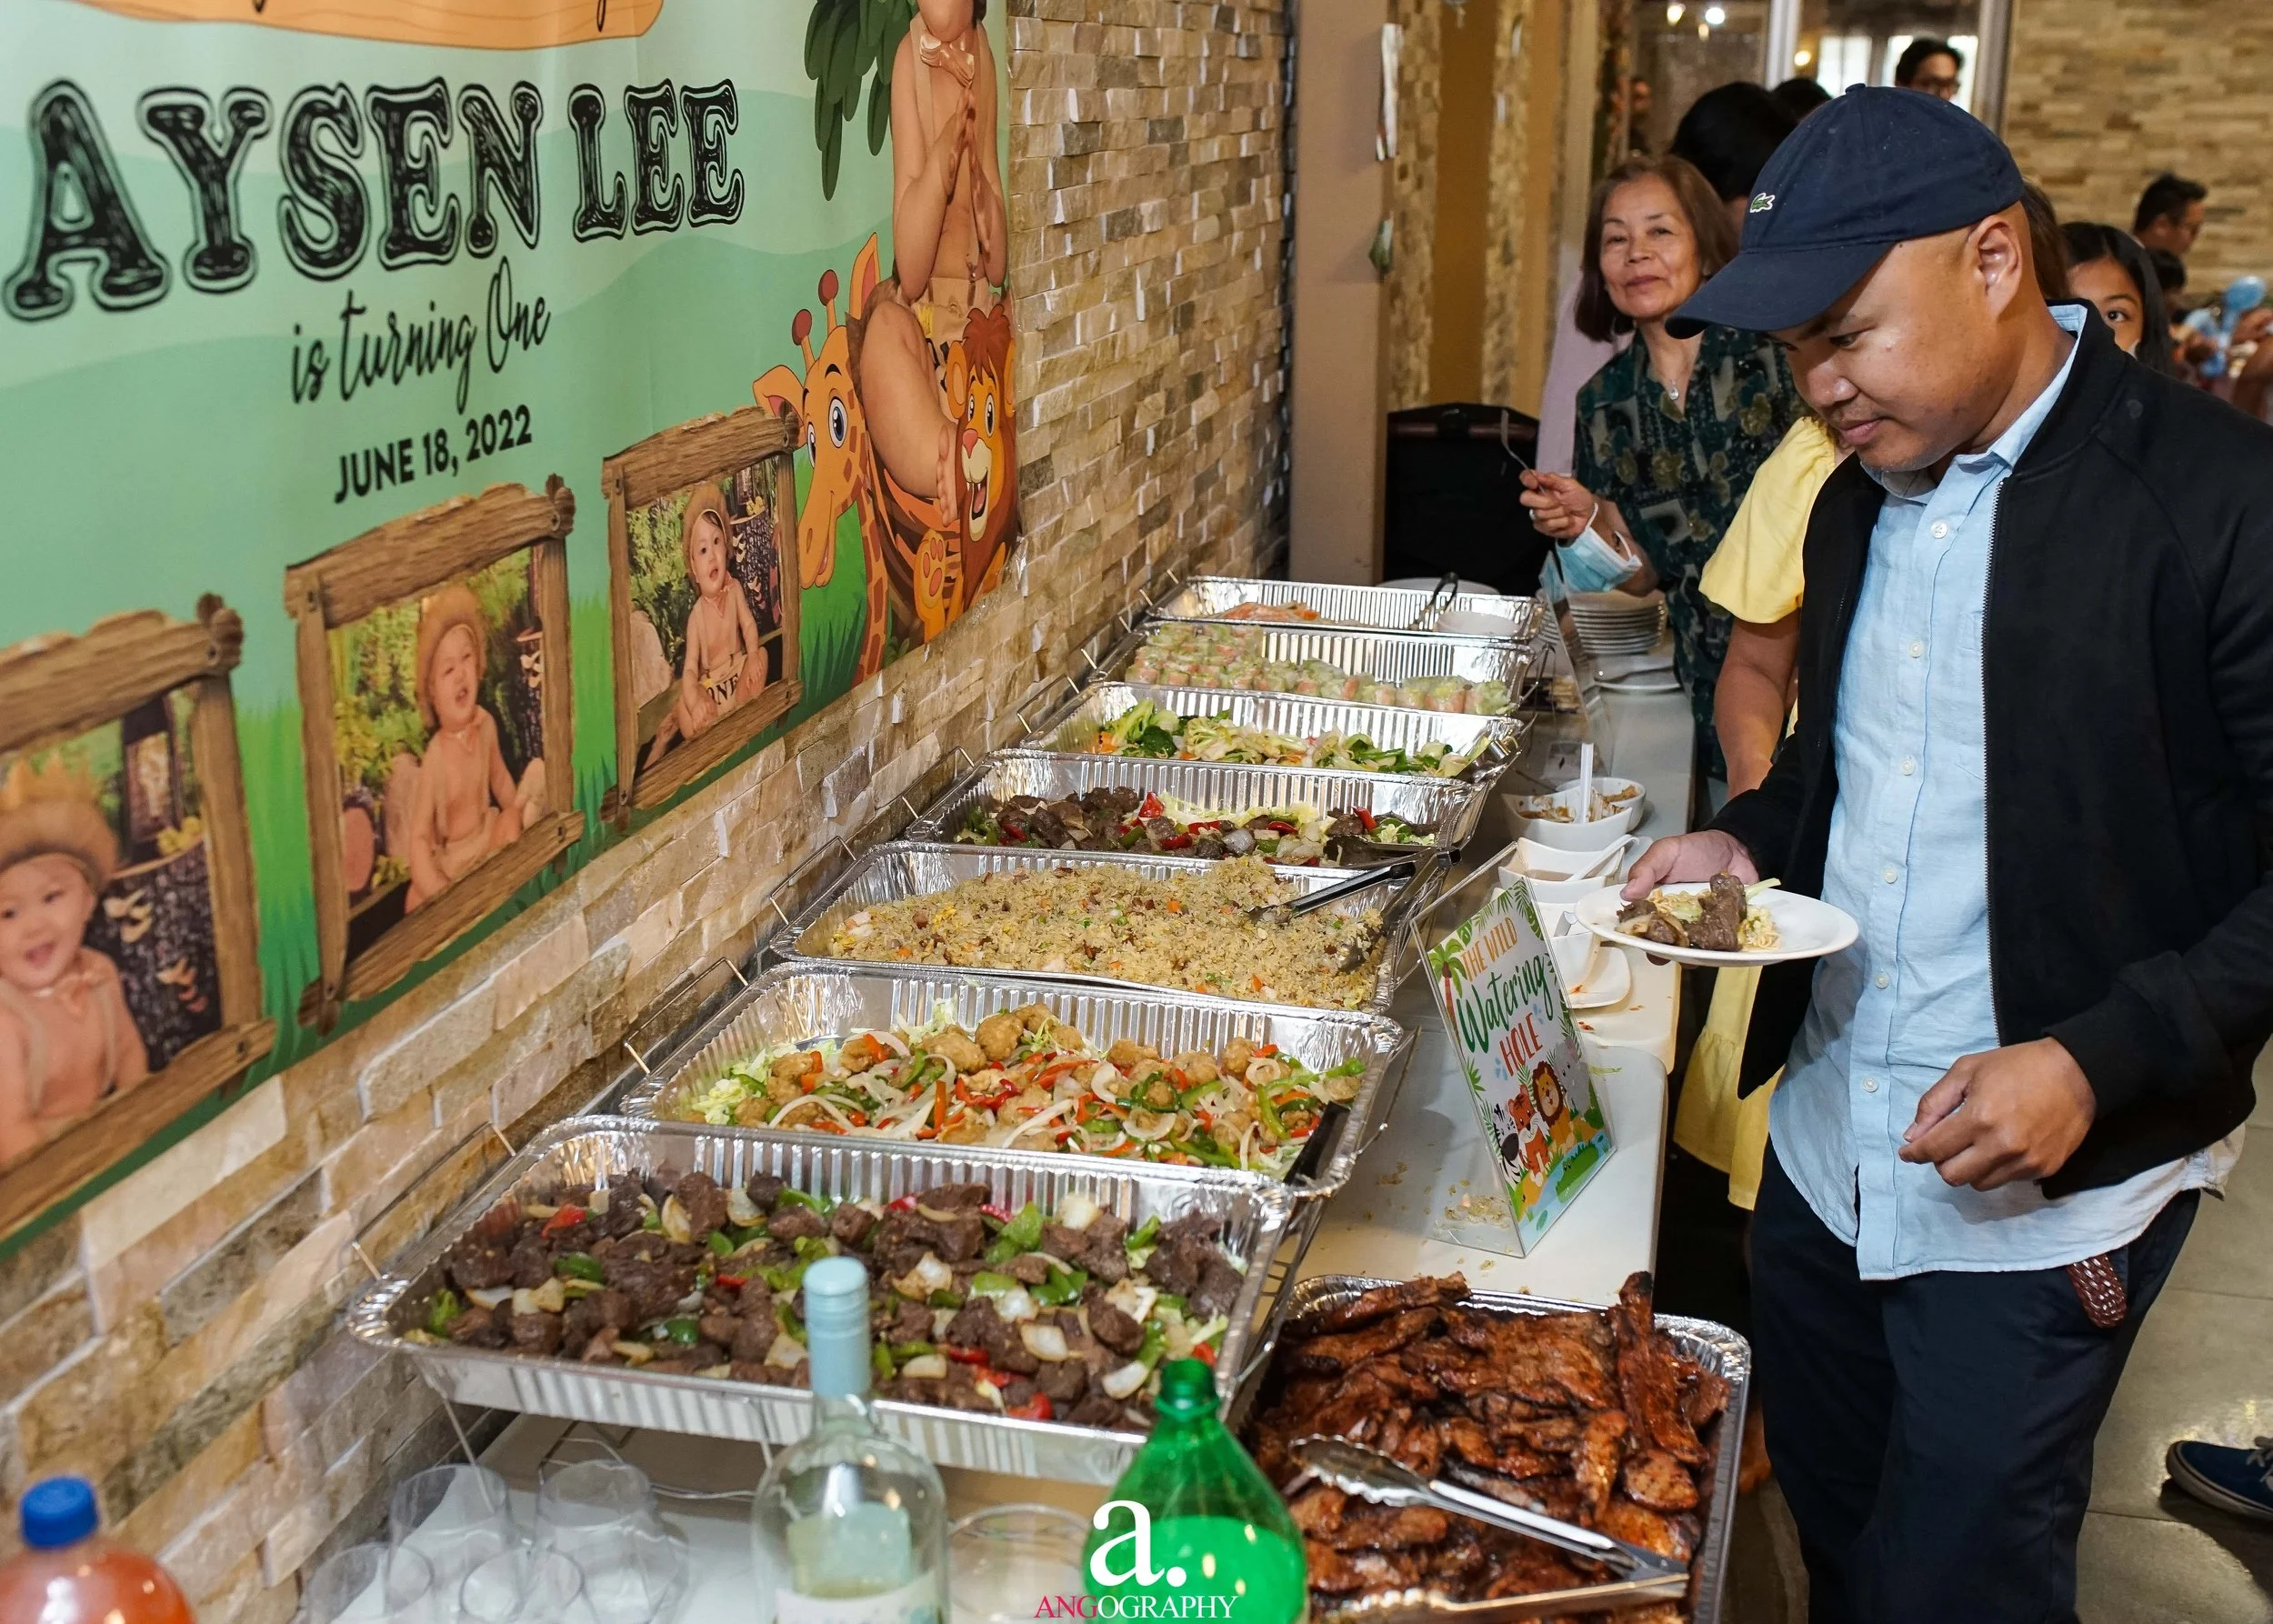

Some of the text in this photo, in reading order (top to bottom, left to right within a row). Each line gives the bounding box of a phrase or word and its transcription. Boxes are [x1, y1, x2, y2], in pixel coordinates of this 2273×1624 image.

[3, 76, 745, 323] AYSEN LEE
[292, 256, 551, 416] is turning One
[334, 405, 532, 504] JUNE 18, 2022
[1461, 917, 1518, 983] THE WILD
[1456, 955, 1554, 1054] Watering
[1499, 1012, 1543, 1077] HOLE
